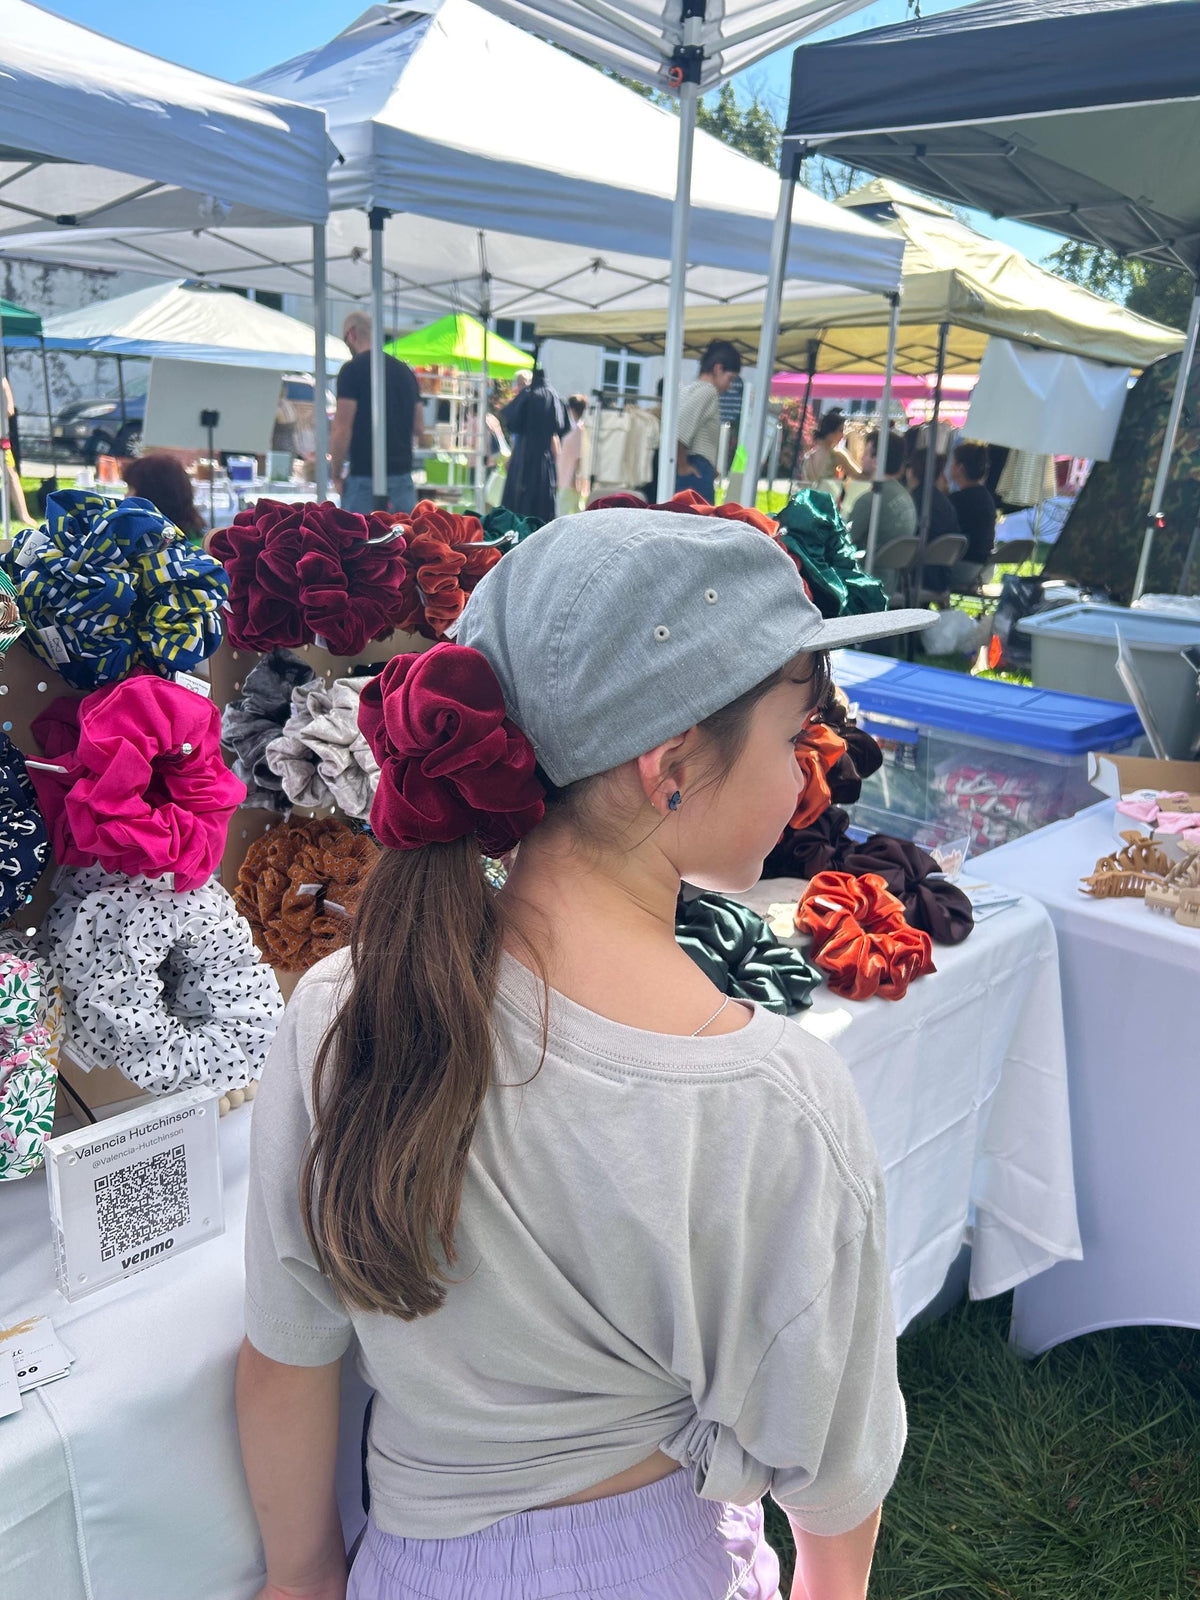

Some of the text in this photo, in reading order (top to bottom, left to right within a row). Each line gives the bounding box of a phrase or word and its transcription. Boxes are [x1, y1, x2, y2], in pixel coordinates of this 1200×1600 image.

[75, 1108, 196, 1160] Valencia Hutchinson
[92, 1128, 184, 1169] @Valencia-Hutchinson
[121, 1238, 174, 1270] venmo
